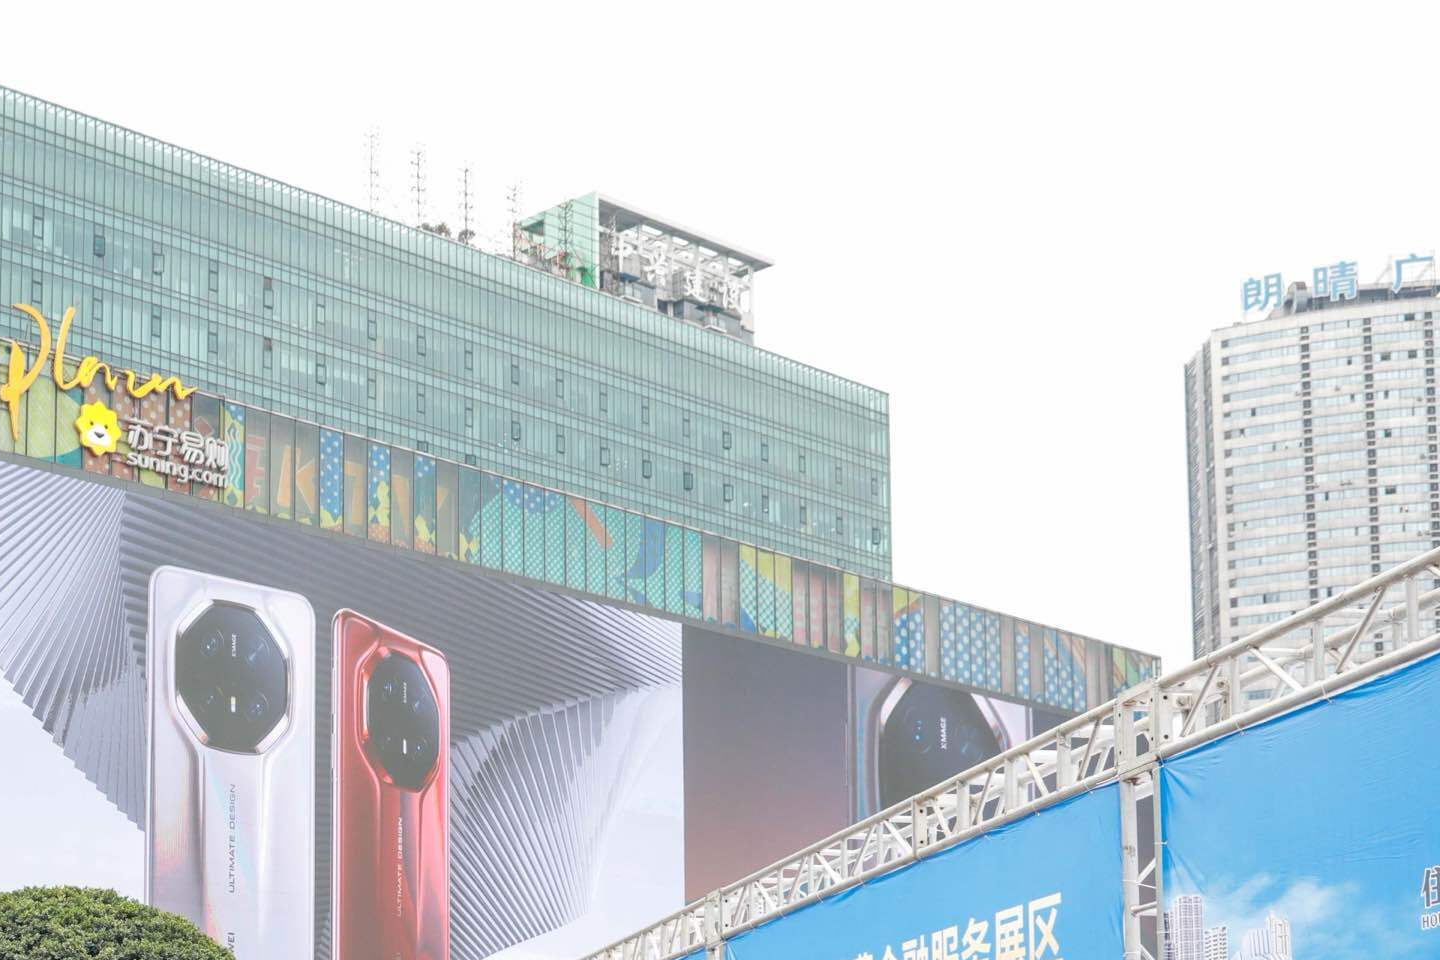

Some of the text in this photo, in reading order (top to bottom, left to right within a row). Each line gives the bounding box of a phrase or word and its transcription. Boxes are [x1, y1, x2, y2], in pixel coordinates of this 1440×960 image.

[1242, 253, 1435, 313] 朗晴广
[126, 452, 229, 488] suning.com
[127, 418, 229, 471] 苏宁易购
[228, 835, 236, 893] ULTIMATE
